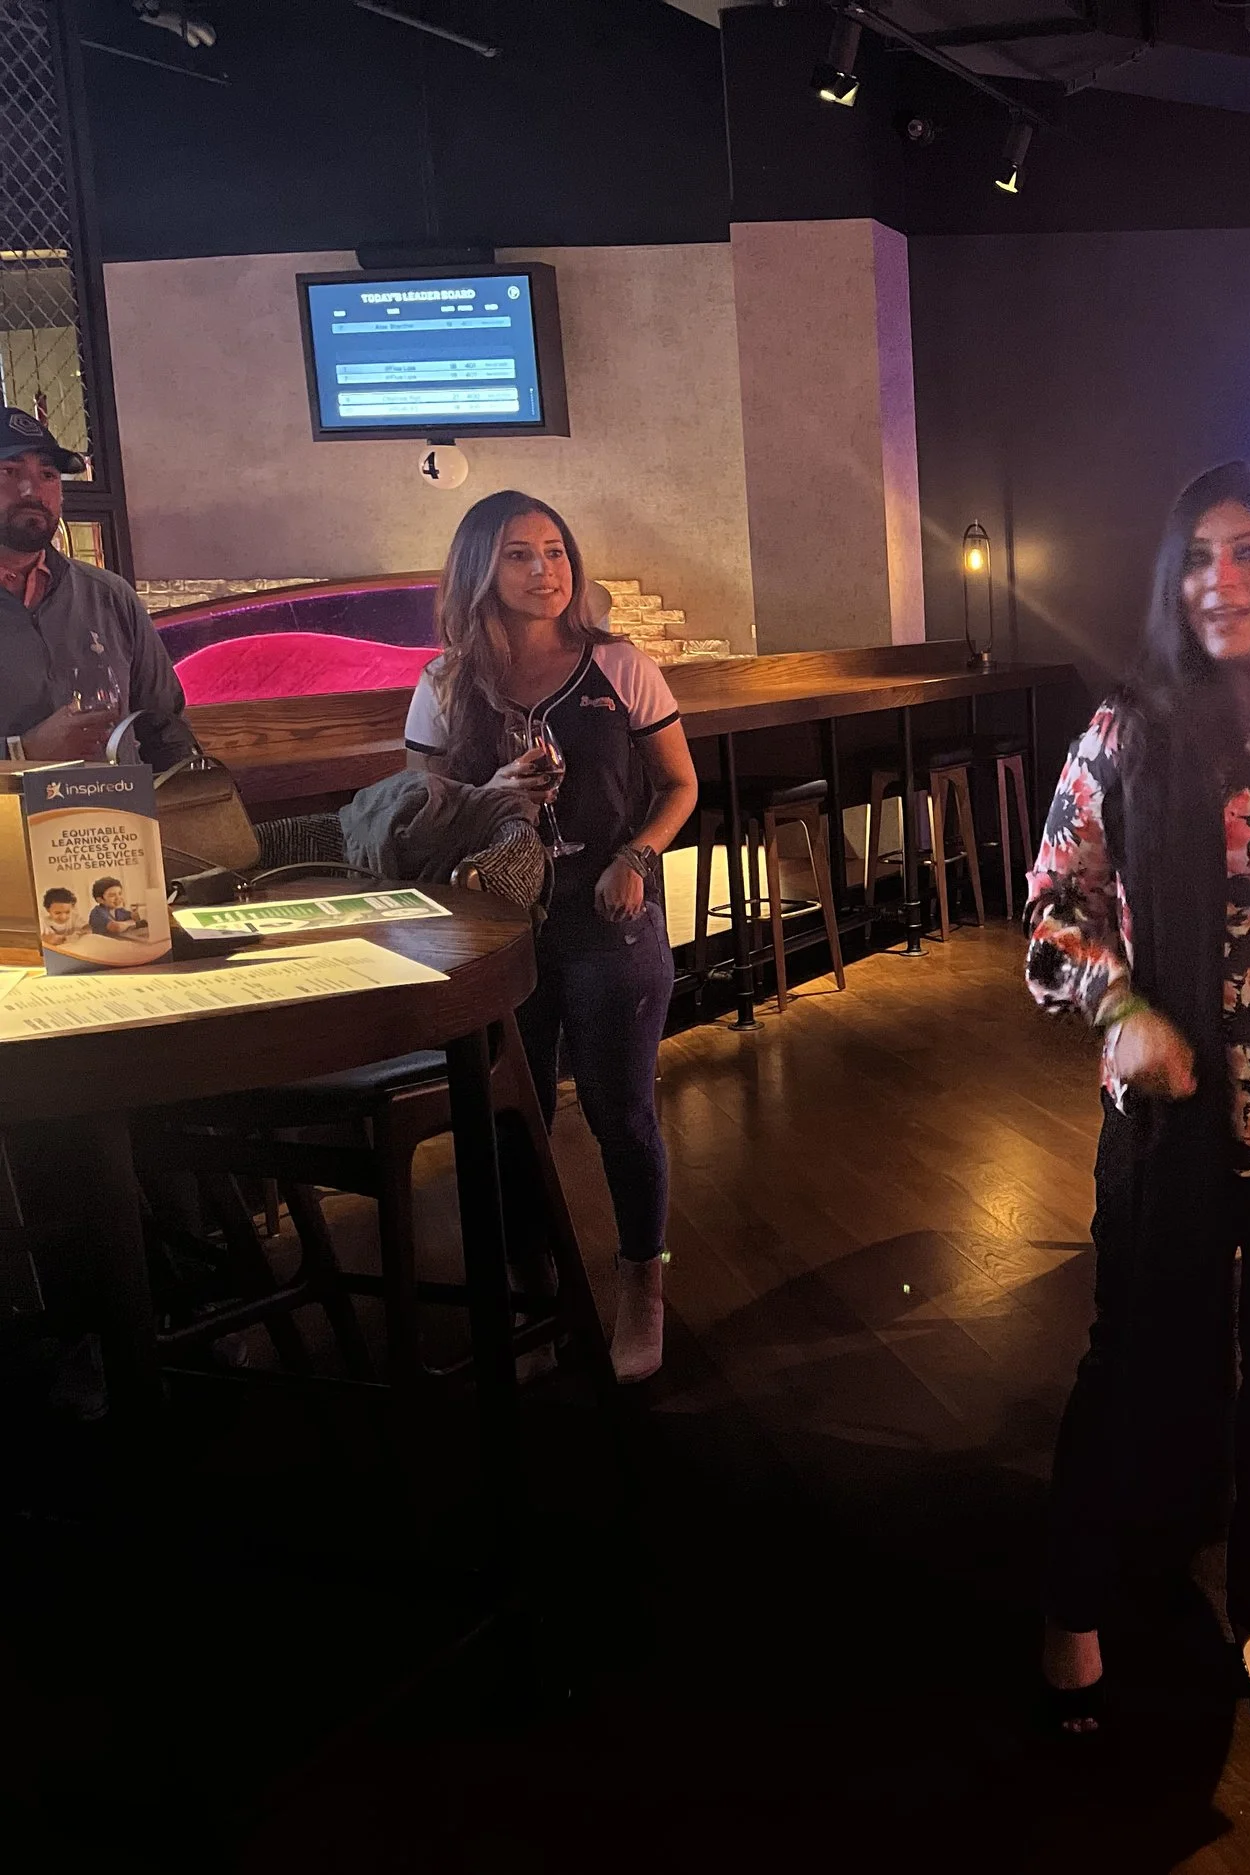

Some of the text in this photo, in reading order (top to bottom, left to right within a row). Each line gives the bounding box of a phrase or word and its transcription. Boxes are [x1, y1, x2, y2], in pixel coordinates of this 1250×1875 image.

[361, 289, 475, 303] TODAY'S LEADER BOARD
[422, 451, 440, 480] 4
[65, 780, 133, 796] inspiredu
[62, 826, 125, 838] EQUITABLE
[51, 833, 138, 847] LEARNING AND
[65, 844, 109, 854] ACCESS
[48, 849, 144, 864] DIGITAL DEVICES
[56, 858, 139, 872] AND SERVICES
